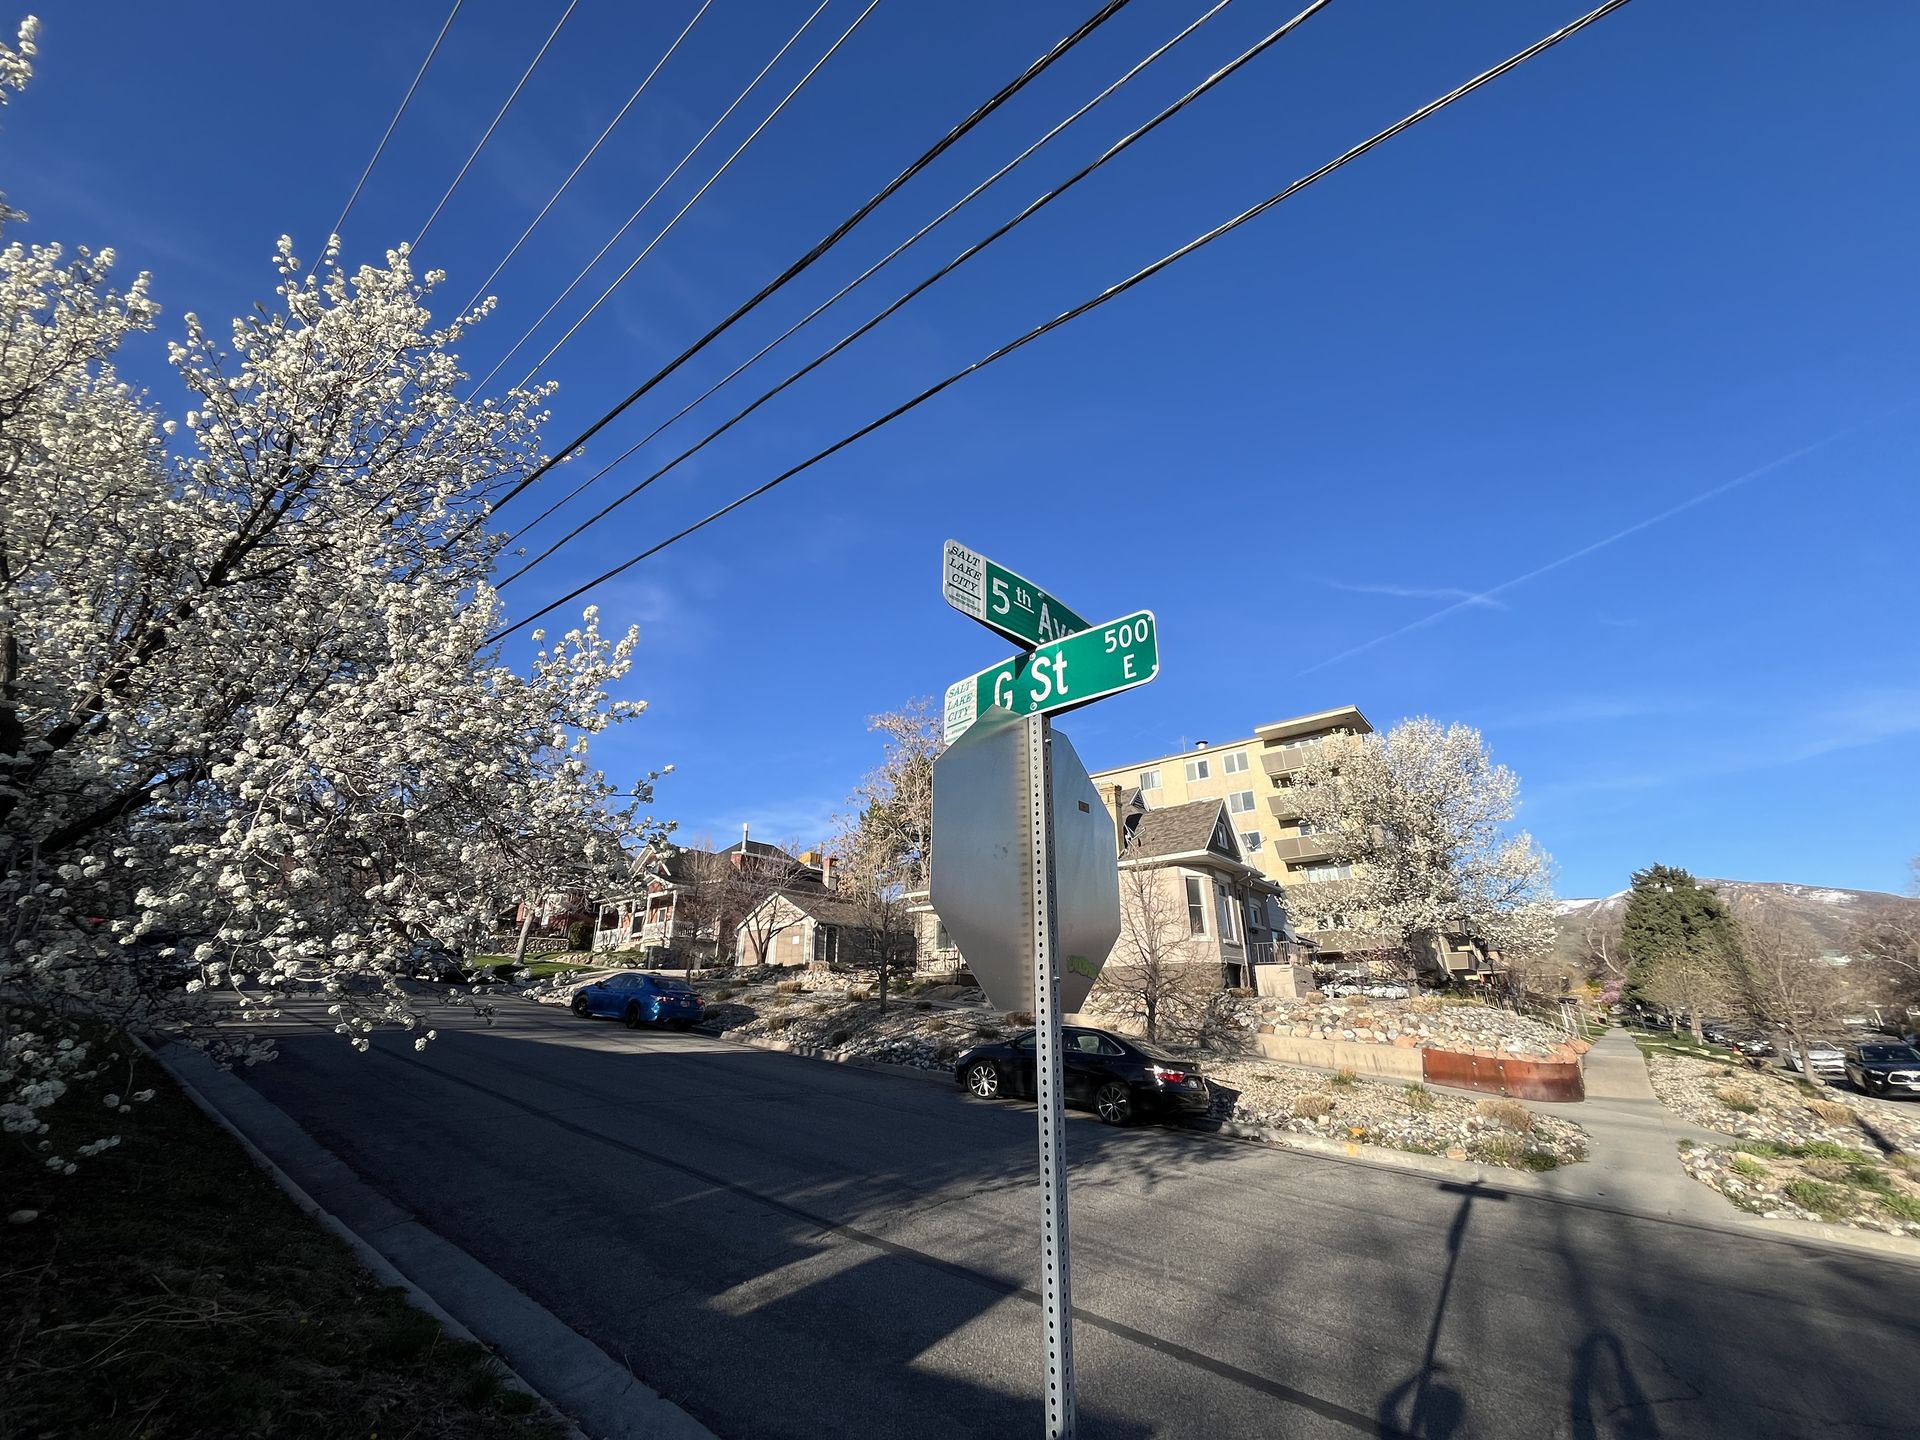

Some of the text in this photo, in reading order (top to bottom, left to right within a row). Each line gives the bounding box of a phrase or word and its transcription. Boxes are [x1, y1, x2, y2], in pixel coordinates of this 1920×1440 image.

[951, 545, 981, 567] SALT
[949, 557, 983, 581] LAKE
[952, 573, 979, 592] CITY
[1104, 618, 1149, 653] 500
[1123, 653, 1137, 679] E
[948, 680, 972, 699] SALT
[994, 650, 1069, 711] G St
[947, 692, 973, 711] LAKE
[948, 705, 971, 722] CITY
